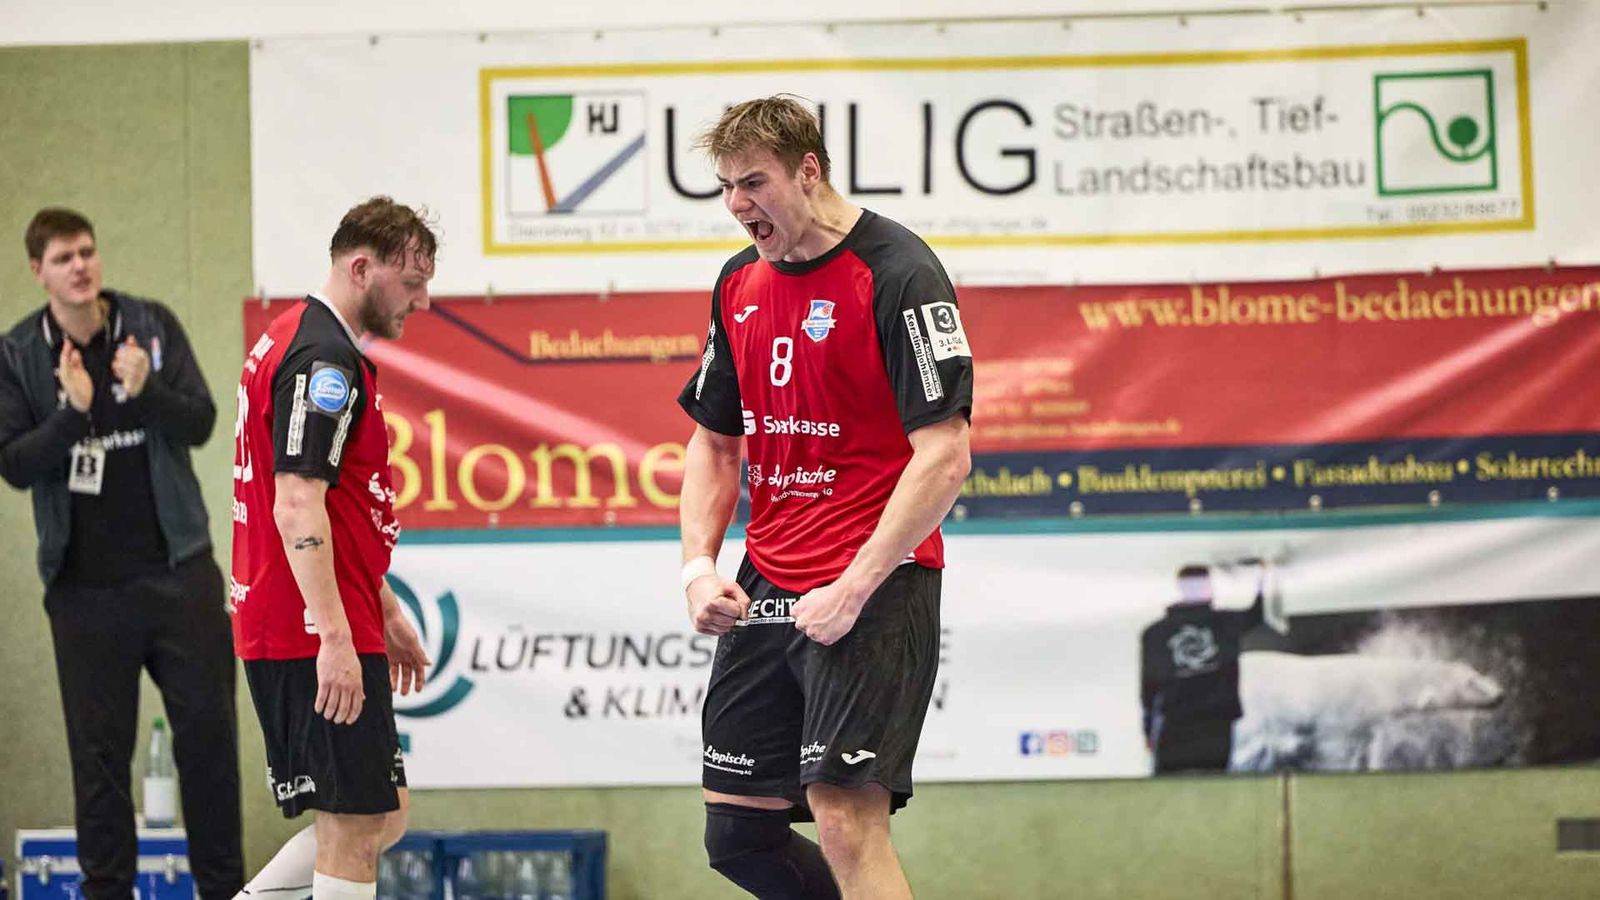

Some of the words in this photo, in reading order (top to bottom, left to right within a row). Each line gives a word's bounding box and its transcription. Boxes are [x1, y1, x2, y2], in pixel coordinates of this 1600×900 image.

[1251, 96, 1339, 134] Tief-
[665, 100, 1038, 200] ULIG
[1054, 153, 1366, 197] Landschaftsbau
[530, 328, 698, 363] Bedachungen
[769, 336, 794, 388] 8
[386, 409, 687, 512] Blome
[1294, 454, 1453, 487] Fassadenbau
[749, 598, 797, 618] ECHT
[564, 686, 588, 719] &
[704, 745, 756, 767] Lippische
